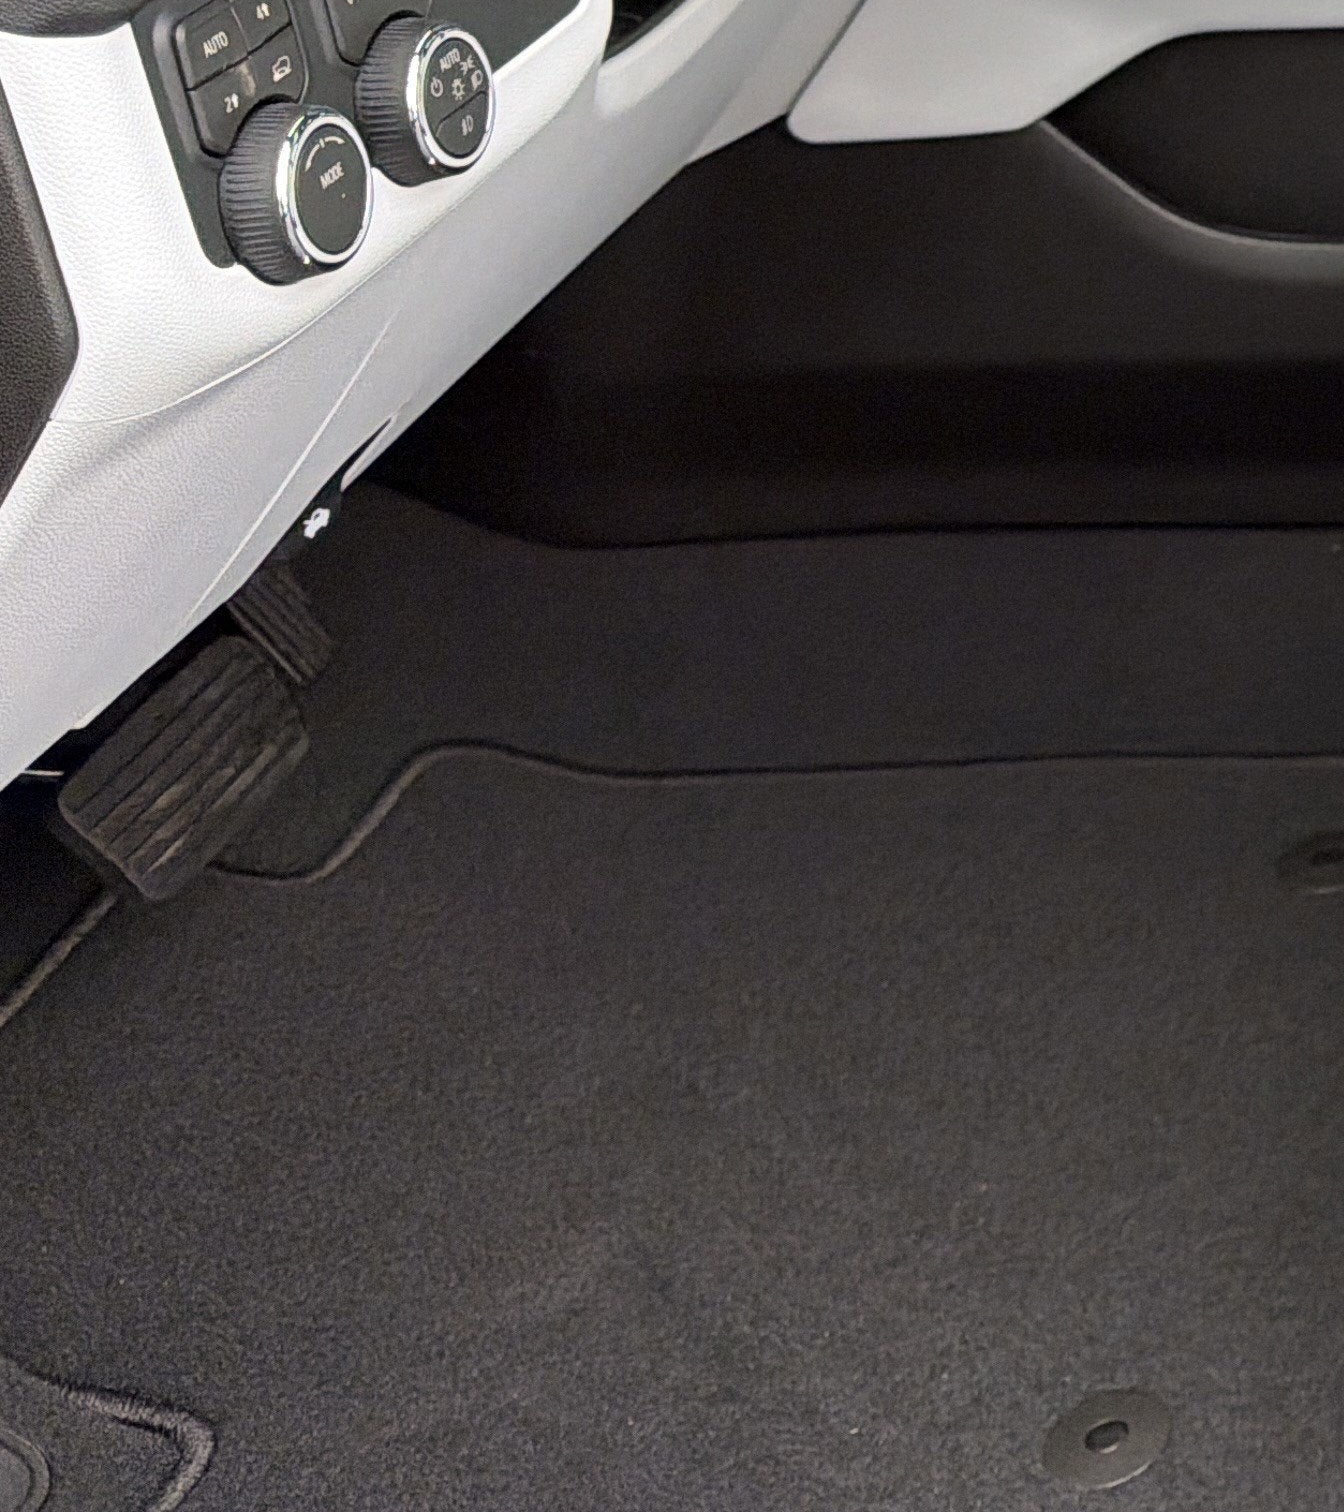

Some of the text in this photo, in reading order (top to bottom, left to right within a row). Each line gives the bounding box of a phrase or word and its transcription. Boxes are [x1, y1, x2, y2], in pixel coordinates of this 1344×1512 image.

[202, 31, 229, 58] AUTO
[439, 47, 461, 70] AUTO
[319, 162, 345, 190] MODE
